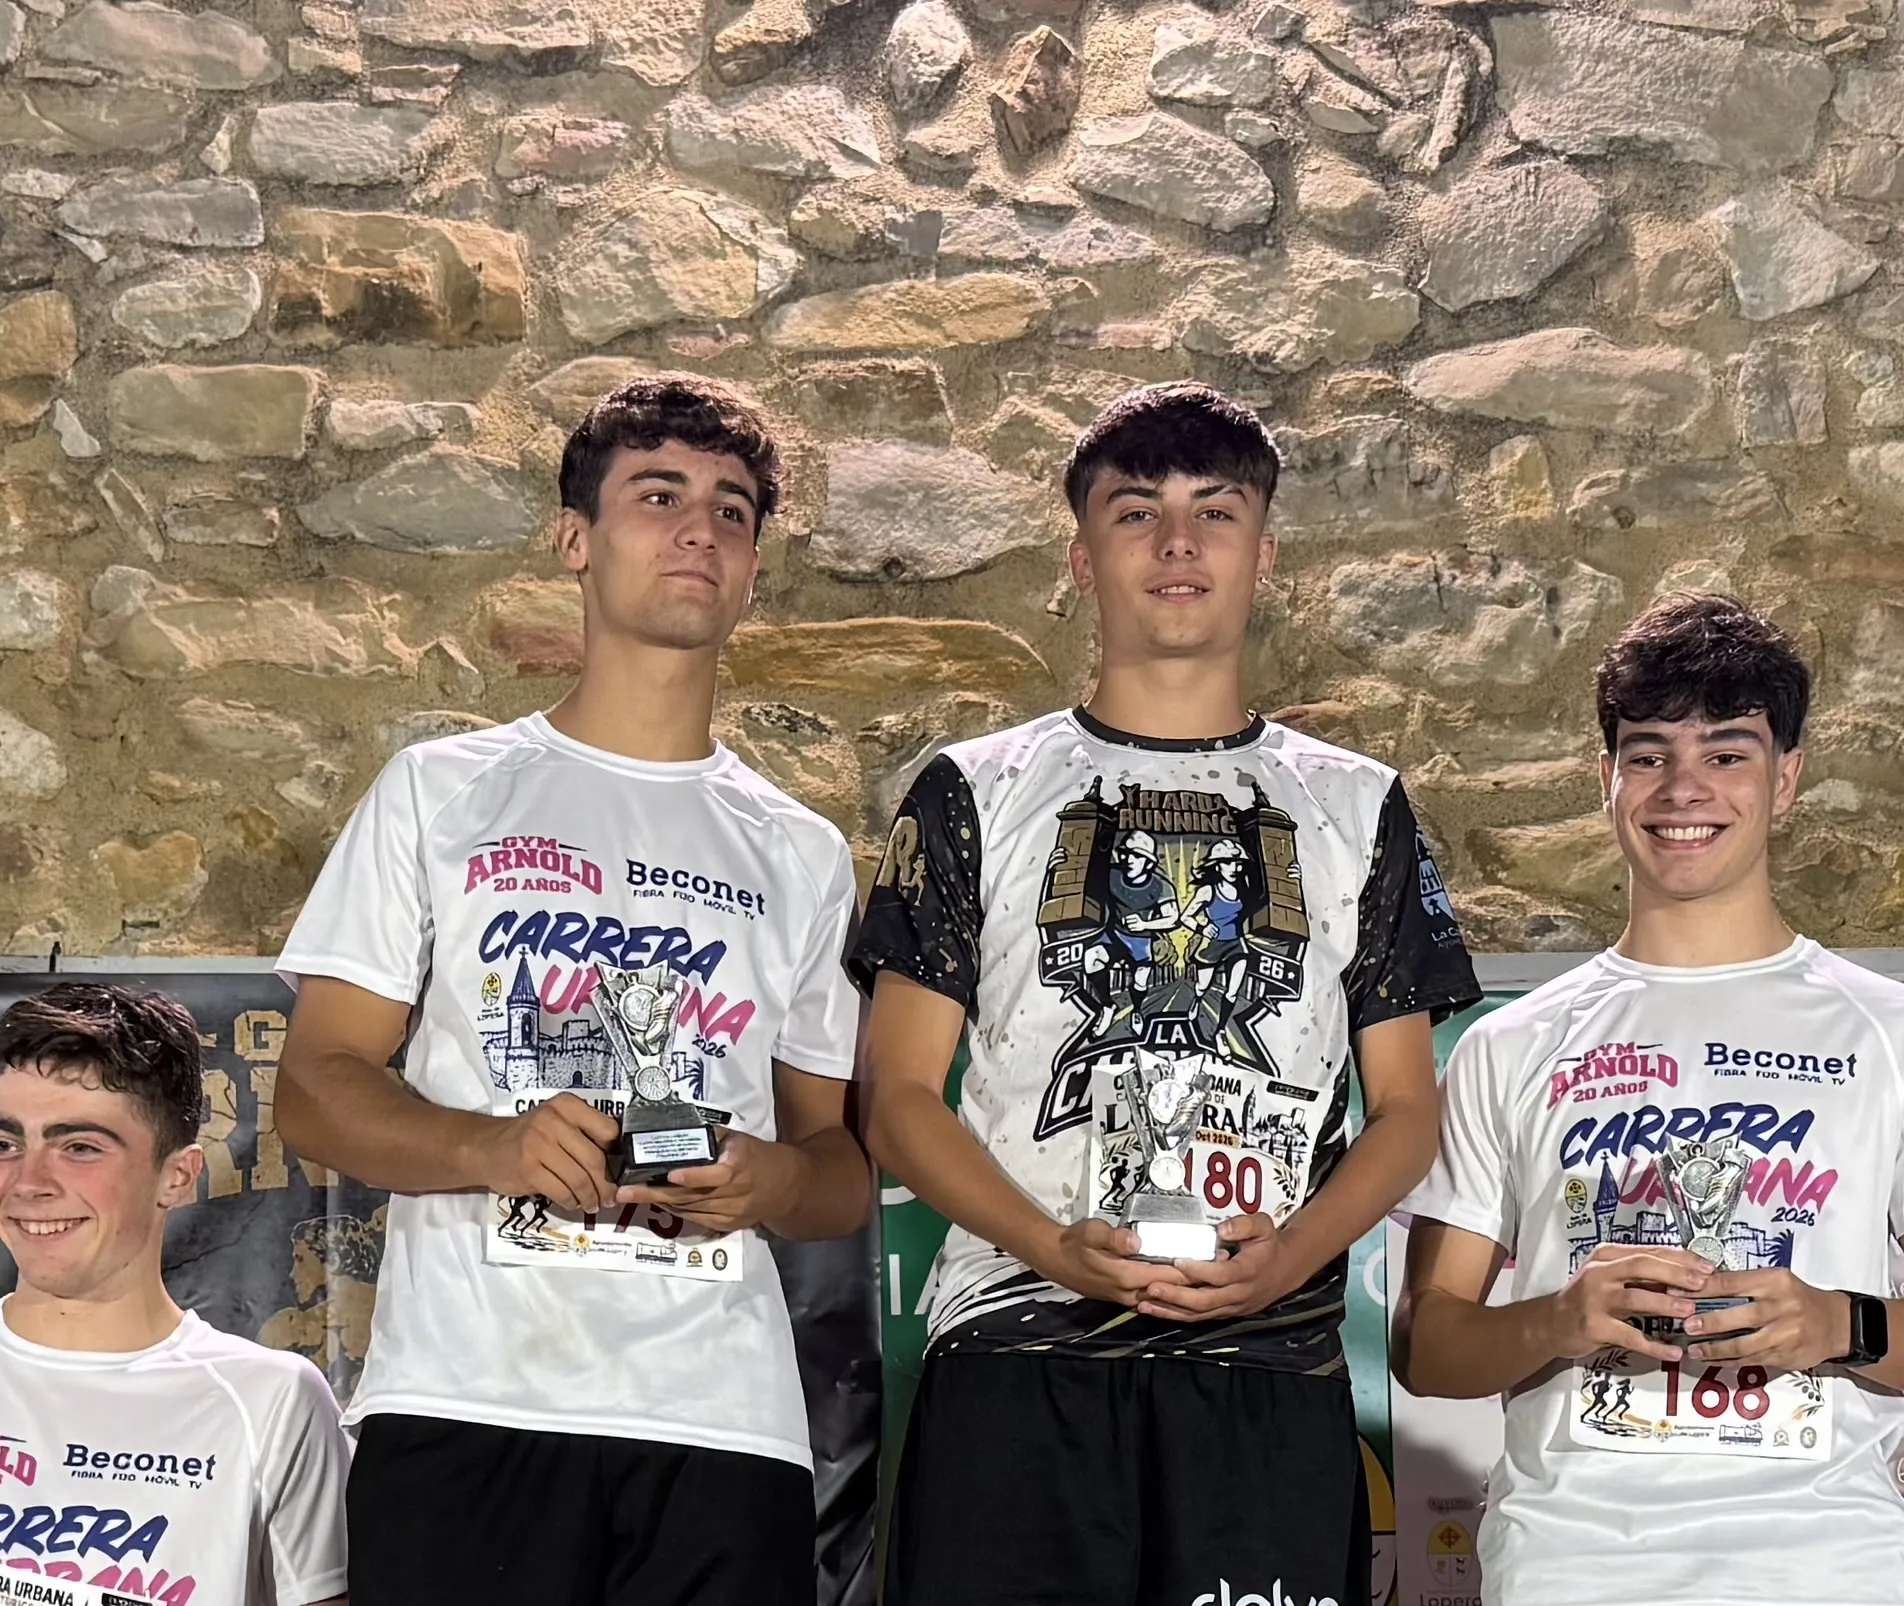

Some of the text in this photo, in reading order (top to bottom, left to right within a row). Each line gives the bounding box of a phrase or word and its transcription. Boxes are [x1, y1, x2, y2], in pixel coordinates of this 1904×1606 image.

[1119, 808, 1236, 833] RUNNING
[501, 836, 558, 850] GYM
[464, 849, 603, 895] ARNOLD
[493, 877, 518, 891] 20
[626, 859, 765, 915] Beconet
[478, 909, 727, 985] CARRERA
[1057, 943, 1084, 963] 20
[1259, 955, 1284, 977] 26
[1154, 1024, 1188, 1045] LA
[1704, 1042, 1857, 1078] Beconet
[1546, 1053, 1678, 1110] ARNOLD
[1831, 1077, 1846, 1086] TV
[1573, 1088, 1596, 1103] 20
[1560, 1101, 1815, 1170] CARRERA
[1770, 1206, 1816, 1227] 2026
[1661, 1360, 1770, 1420] 168
[63, 1443, 217, 1481] Beconet
